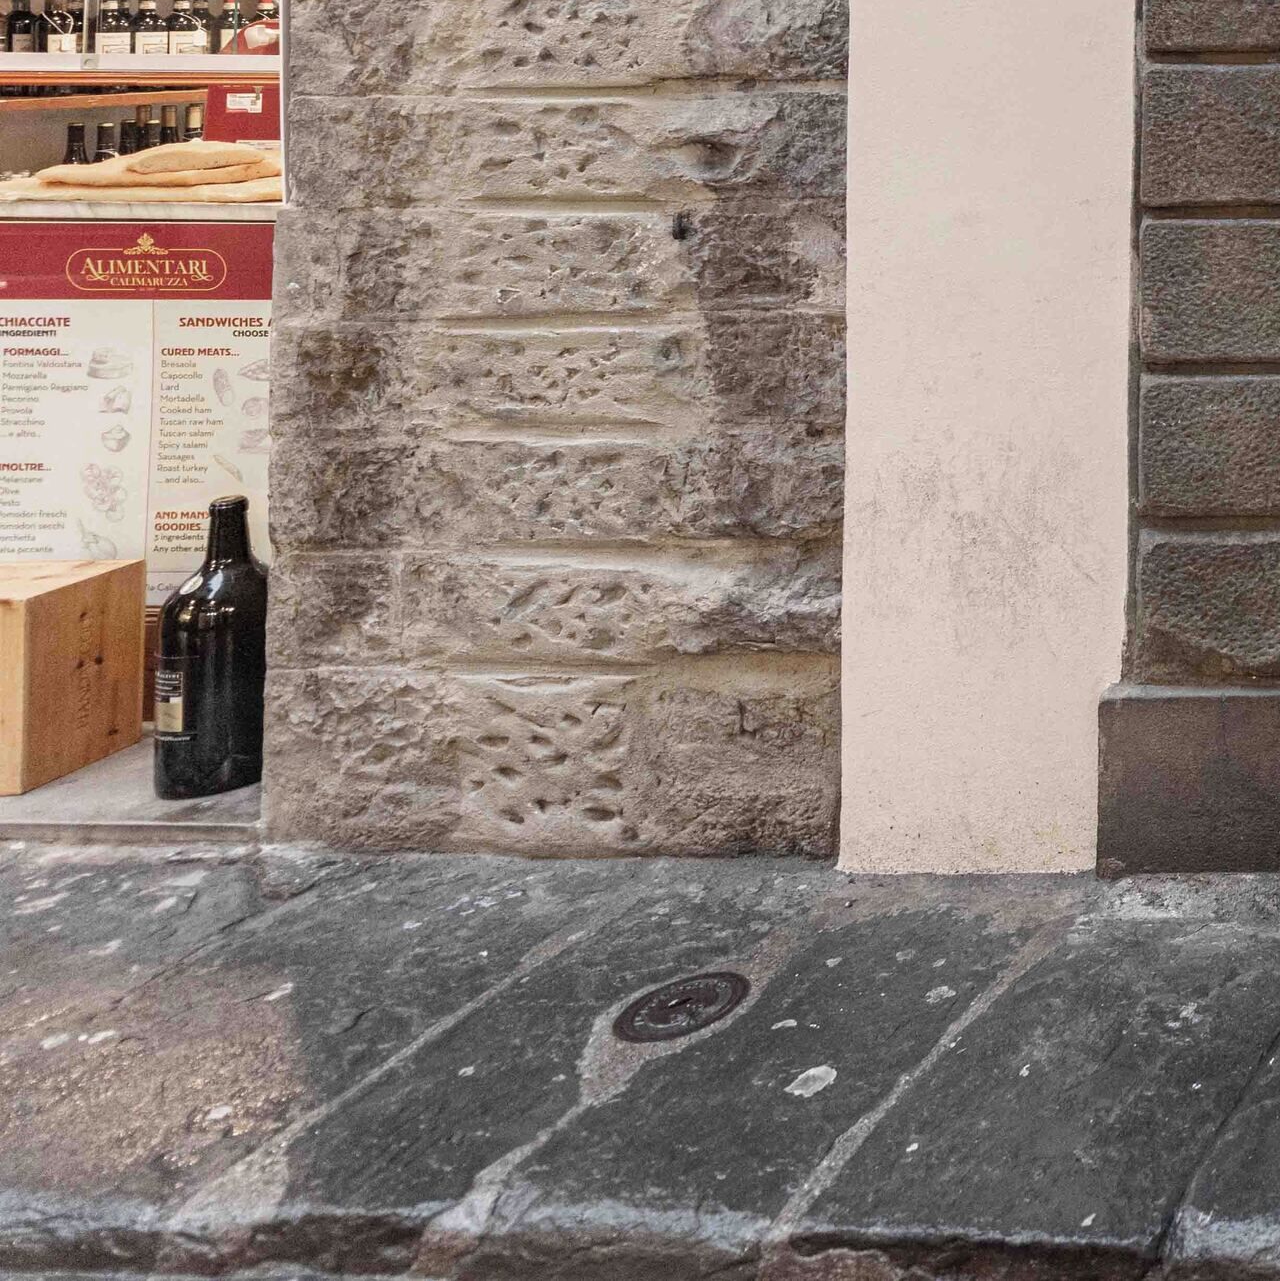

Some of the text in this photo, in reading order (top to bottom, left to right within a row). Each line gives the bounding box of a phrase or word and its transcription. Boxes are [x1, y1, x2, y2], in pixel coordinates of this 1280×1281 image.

[80, 257, 214, 281] ALIMENTARI
[110, 277, 188, 287] CALIMARUZZA
[179, 317, 263, 328] SANDWICHES
[161, 348, 195, 356] CURED
[161, 360, 197, 368] Bresaola
[2, 371, 47, 380] Mozzarella
[160, 371, 203, 381] Capocollo
[2, 383, 49, 393] Parmigiano
[160, 383, 180, 391] Lard
[160, 394, 205, 403] Mortadella
[159, 406, 212, 414] Cooked ham
[159, 417, 187, 426] Tuscan
[206, 417, 224, 426] ham
[159, 429, 214, 437] Tuscan salami
[158, 440, 208, 450] Spicy salami
[157, 452, 195, 462] Sausages
[157, 464, 208, 474] Roast turkey
[165, 476, 180, 484] and
[155, 511, 178, 519] AND
[160, 534, 204, 542] ingredients
[153, 545, 168, 553] Any
